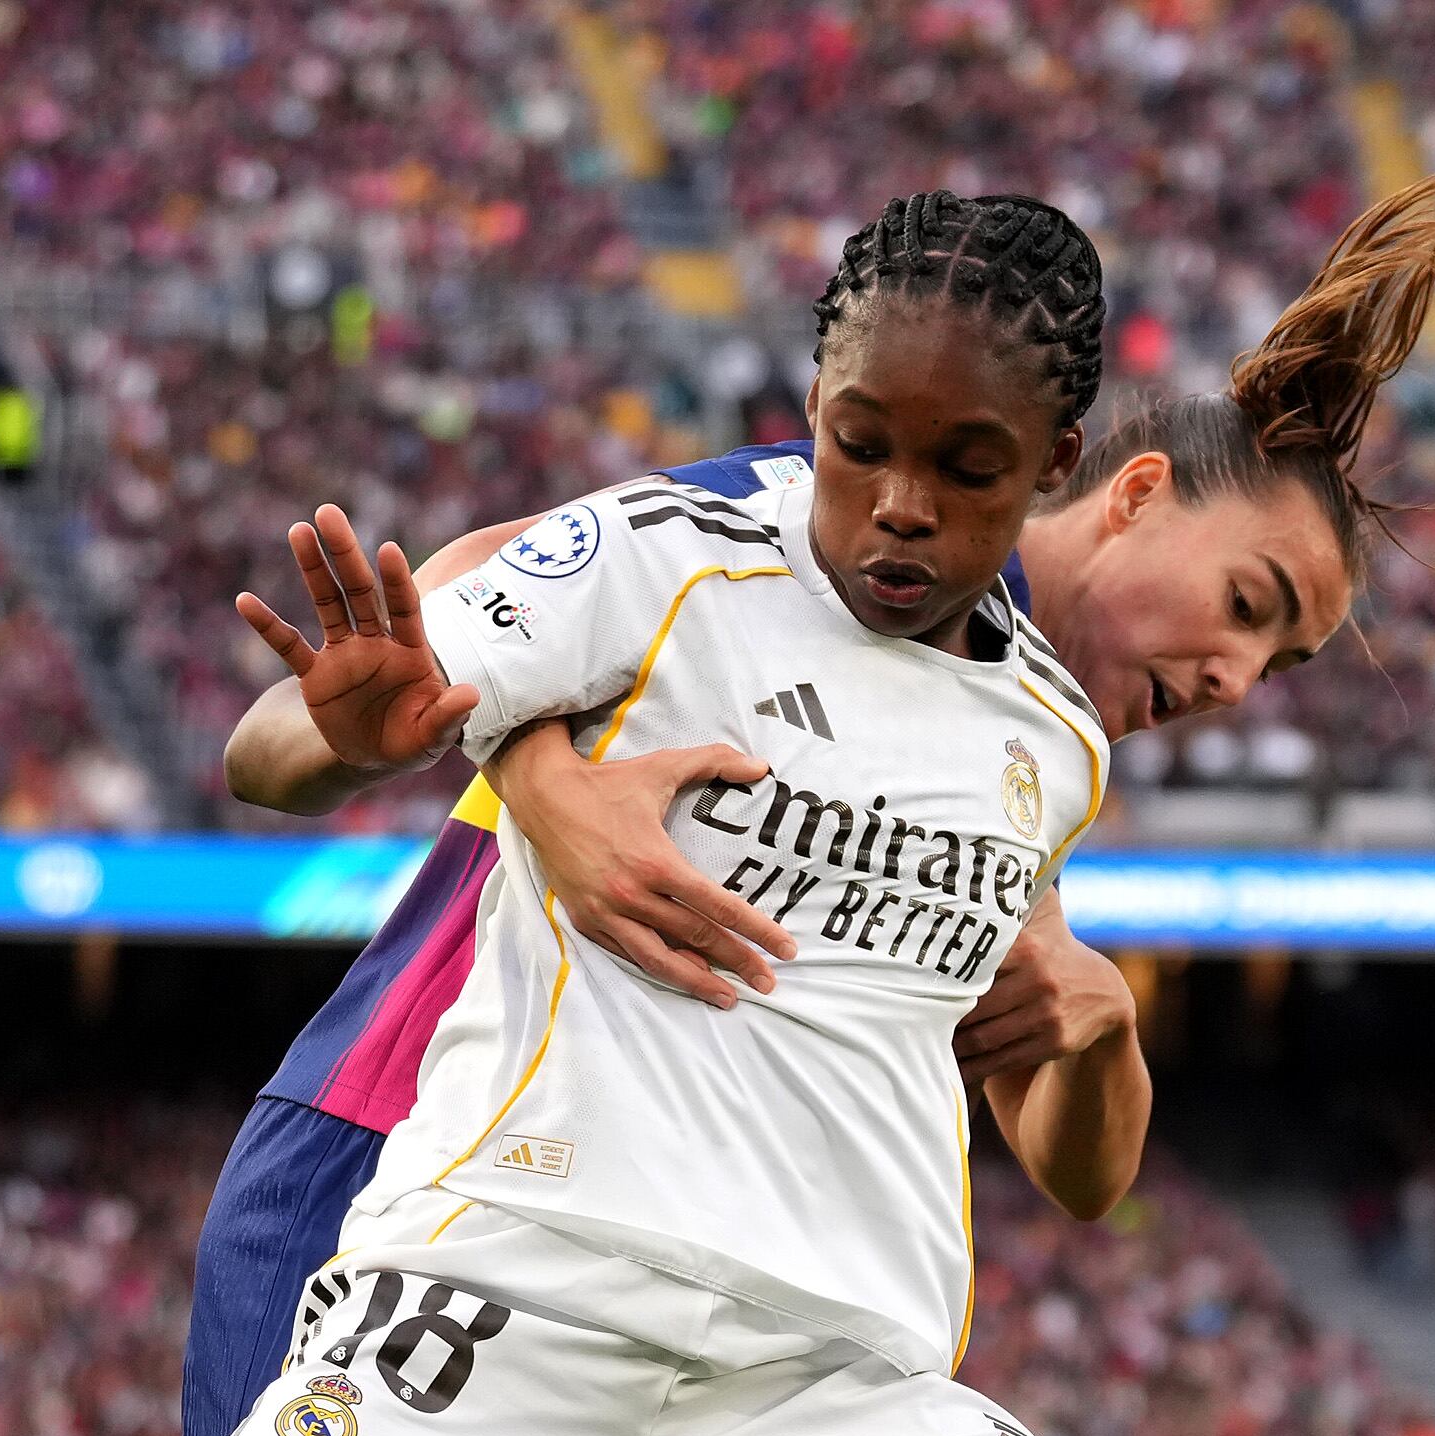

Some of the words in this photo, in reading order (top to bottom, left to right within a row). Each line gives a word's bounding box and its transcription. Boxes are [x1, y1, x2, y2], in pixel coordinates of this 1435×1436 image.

[482, 591, 516, 628] 10
[821, 880, 998, 984] BETTER
[321, 1270, 511, 1414] 18
